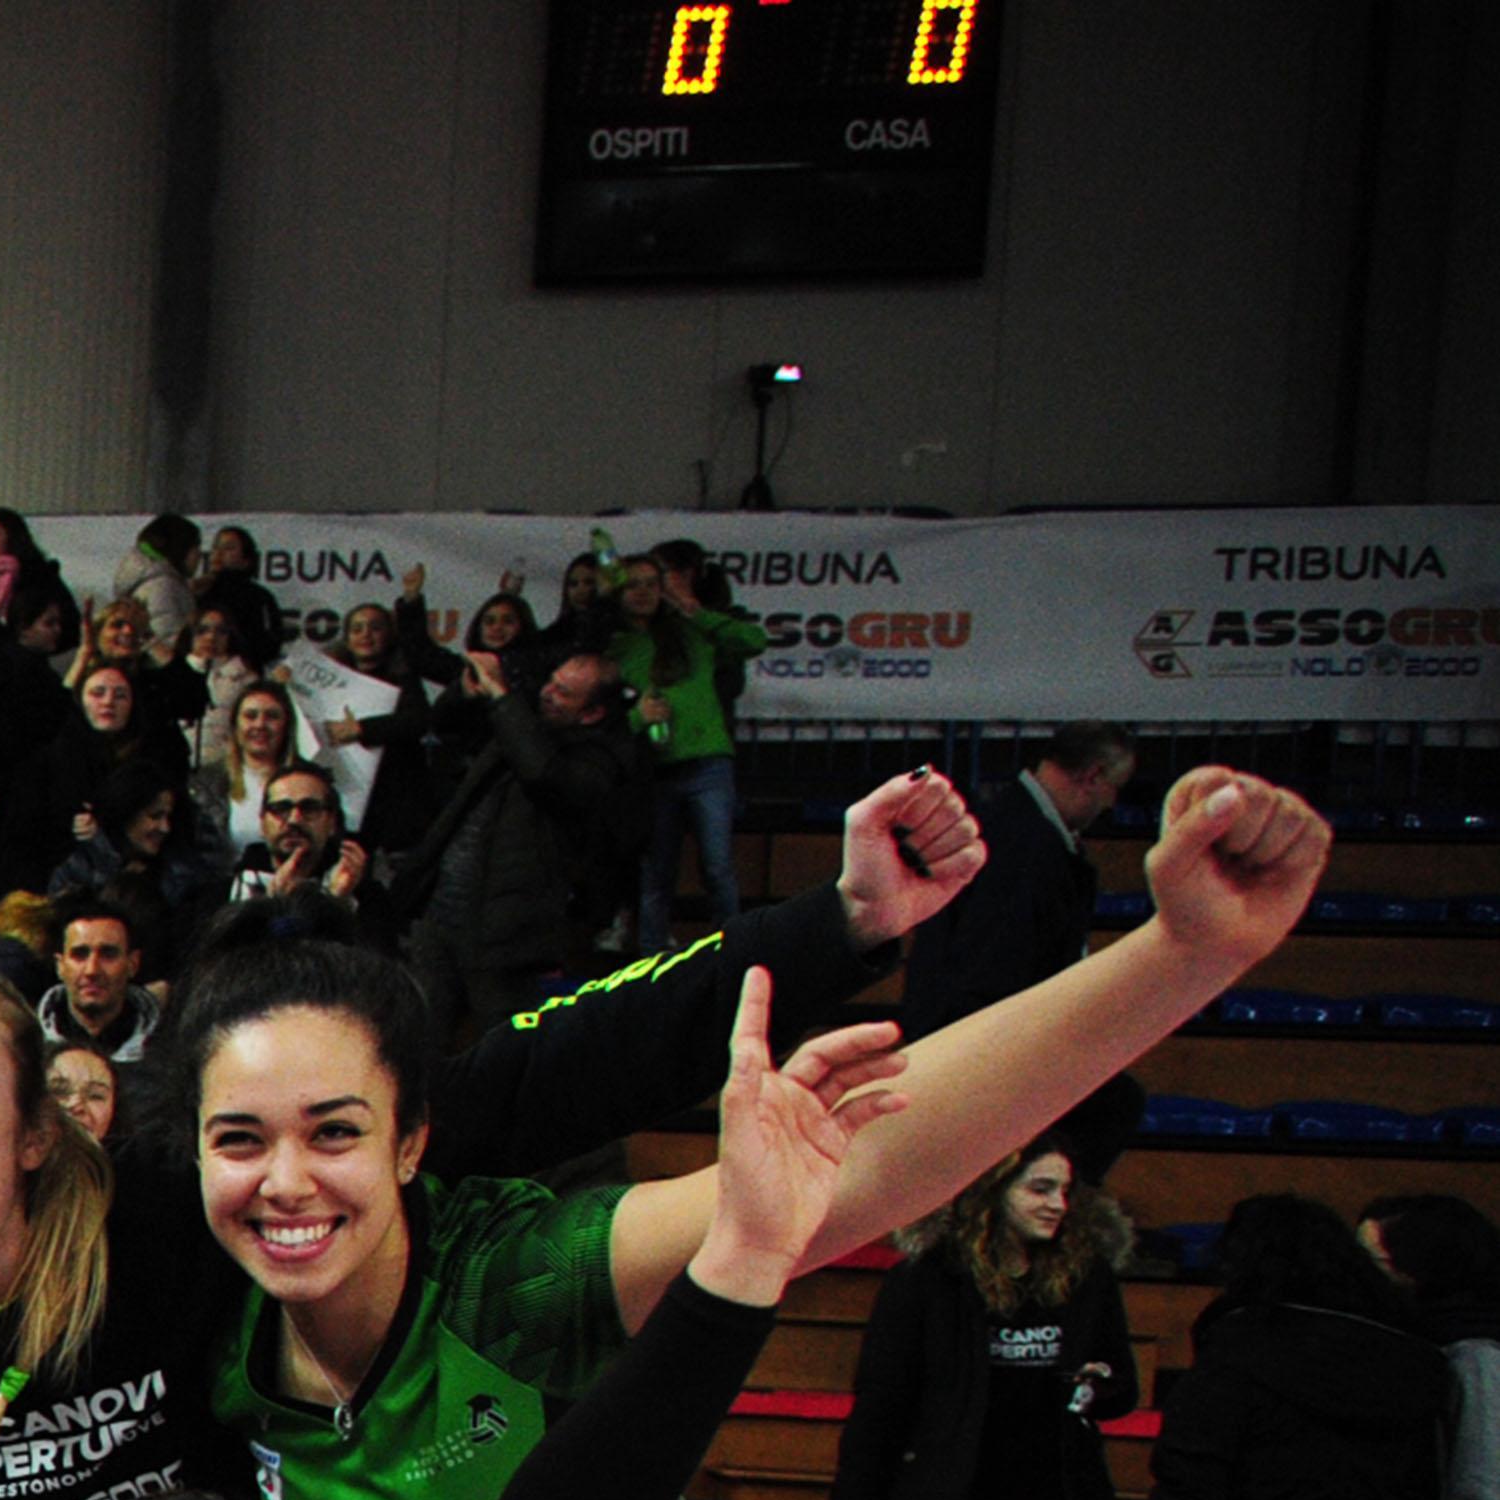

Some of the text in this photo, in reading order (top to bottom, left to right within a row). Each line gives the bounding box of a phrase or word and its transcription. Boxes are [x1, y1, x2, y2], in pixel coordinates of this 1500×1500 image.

[661, 0, 976, 96] 0 0
[589, 119, 930, 160] OSPITI CASA
[1215, 545, 1446, 582] TRIBUNA
[756, 657, 931, 678] NOLO 2000
[1291, 657, 1364, 677] NOLO
[1405, 657, 1481, 676] 2000
